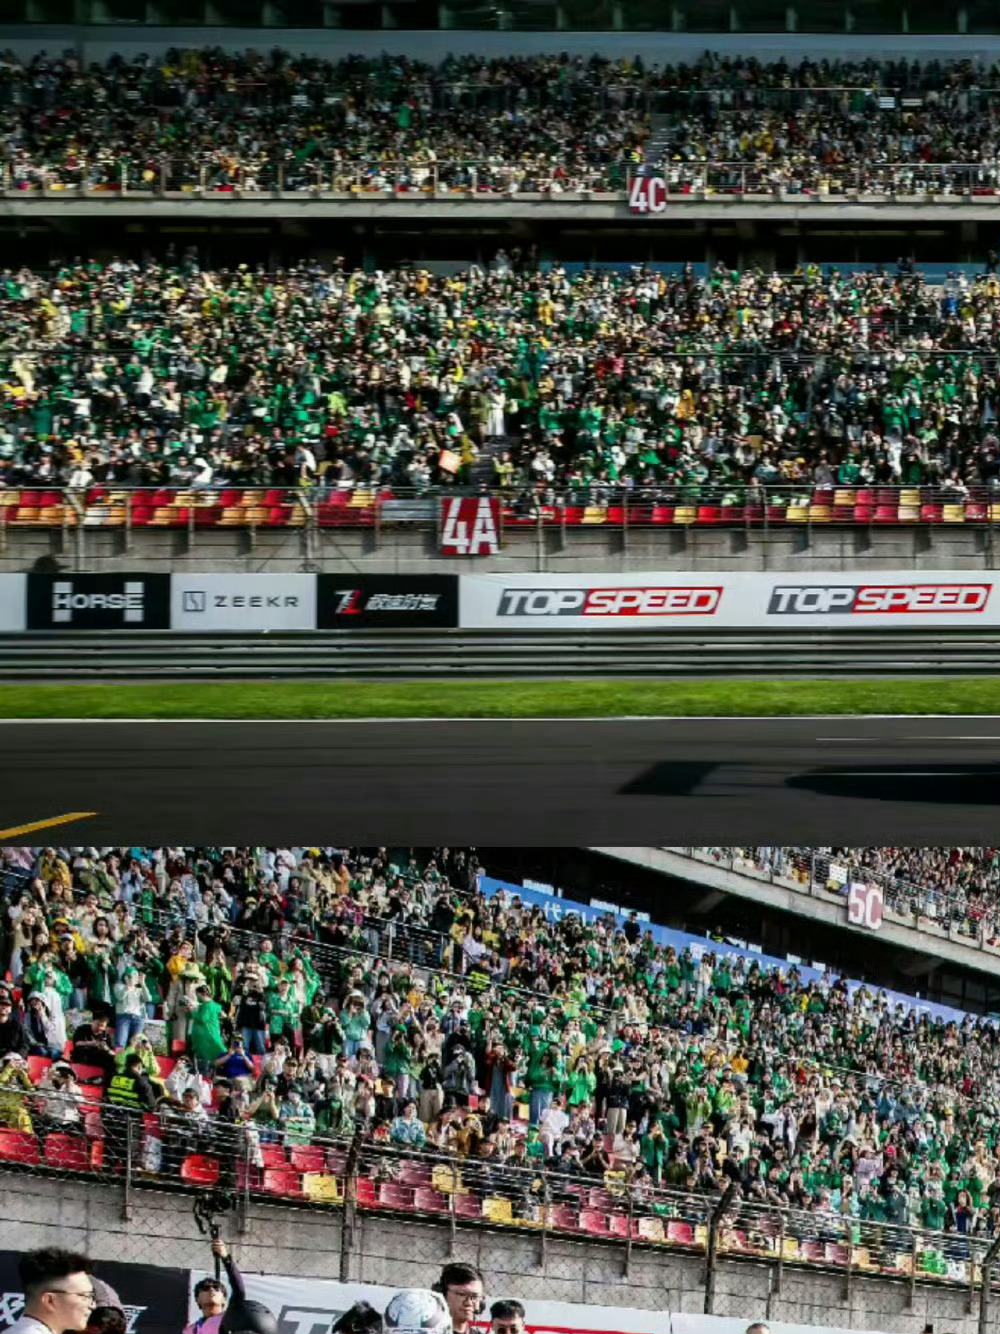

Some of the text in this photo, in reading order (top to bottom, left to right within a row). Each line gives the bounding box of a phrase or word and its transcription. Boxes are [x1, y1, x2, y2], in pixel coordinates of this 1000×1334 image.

[629, 177, 667, 212] 4C
[442, 497, 500, 554] 4A
[213, 595, 299, 608] ZEEKR
[503, 588, 721, 616] TOP SPEED
[773, 585, 988, 613] TOP SPEED
[848, 883, 883, 930] 5C
